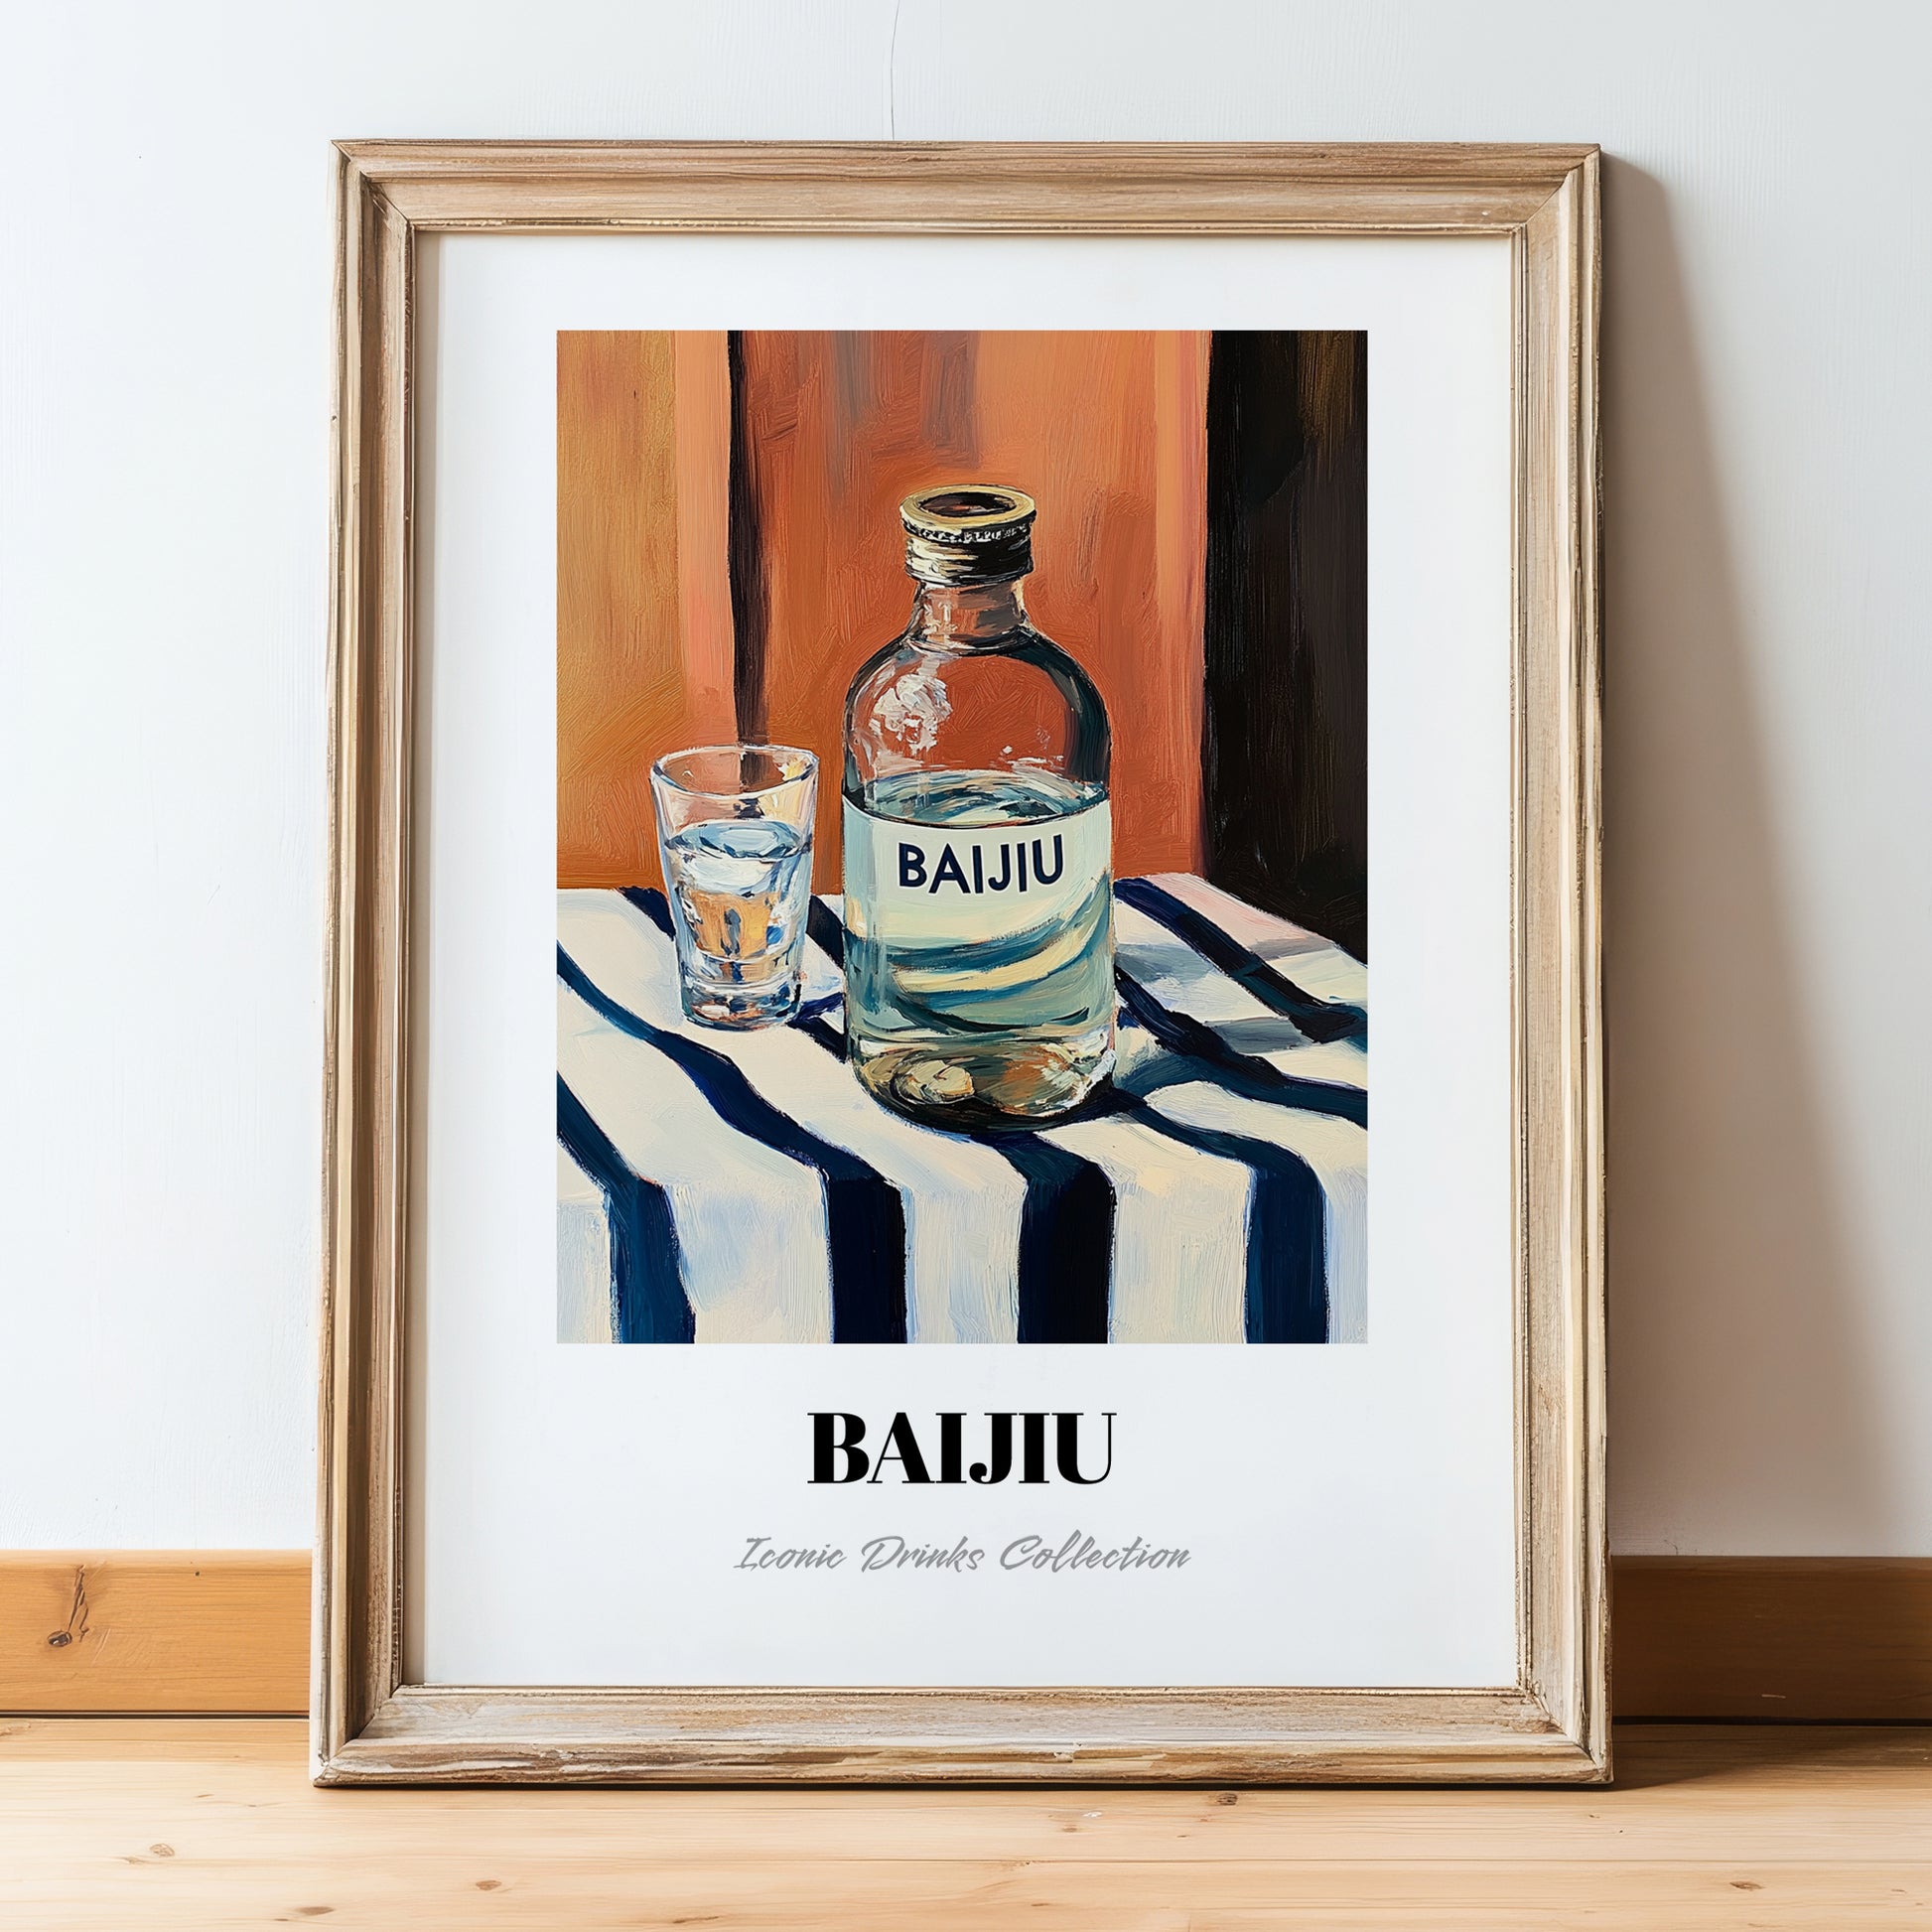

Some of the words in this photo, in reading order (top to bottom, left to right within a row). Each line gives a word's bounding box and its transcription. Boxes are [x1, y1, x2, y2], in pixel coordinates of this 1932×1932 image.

[898, 834, 1063, 894] BAIJIU
[807, 1412, 1117, 1484] BAIJIU
[733, 1536, 848, 1572] Iconic
[860, 1535, 986, 1573] Drinks
[1000, 1529, 1192, 1573] Collection
